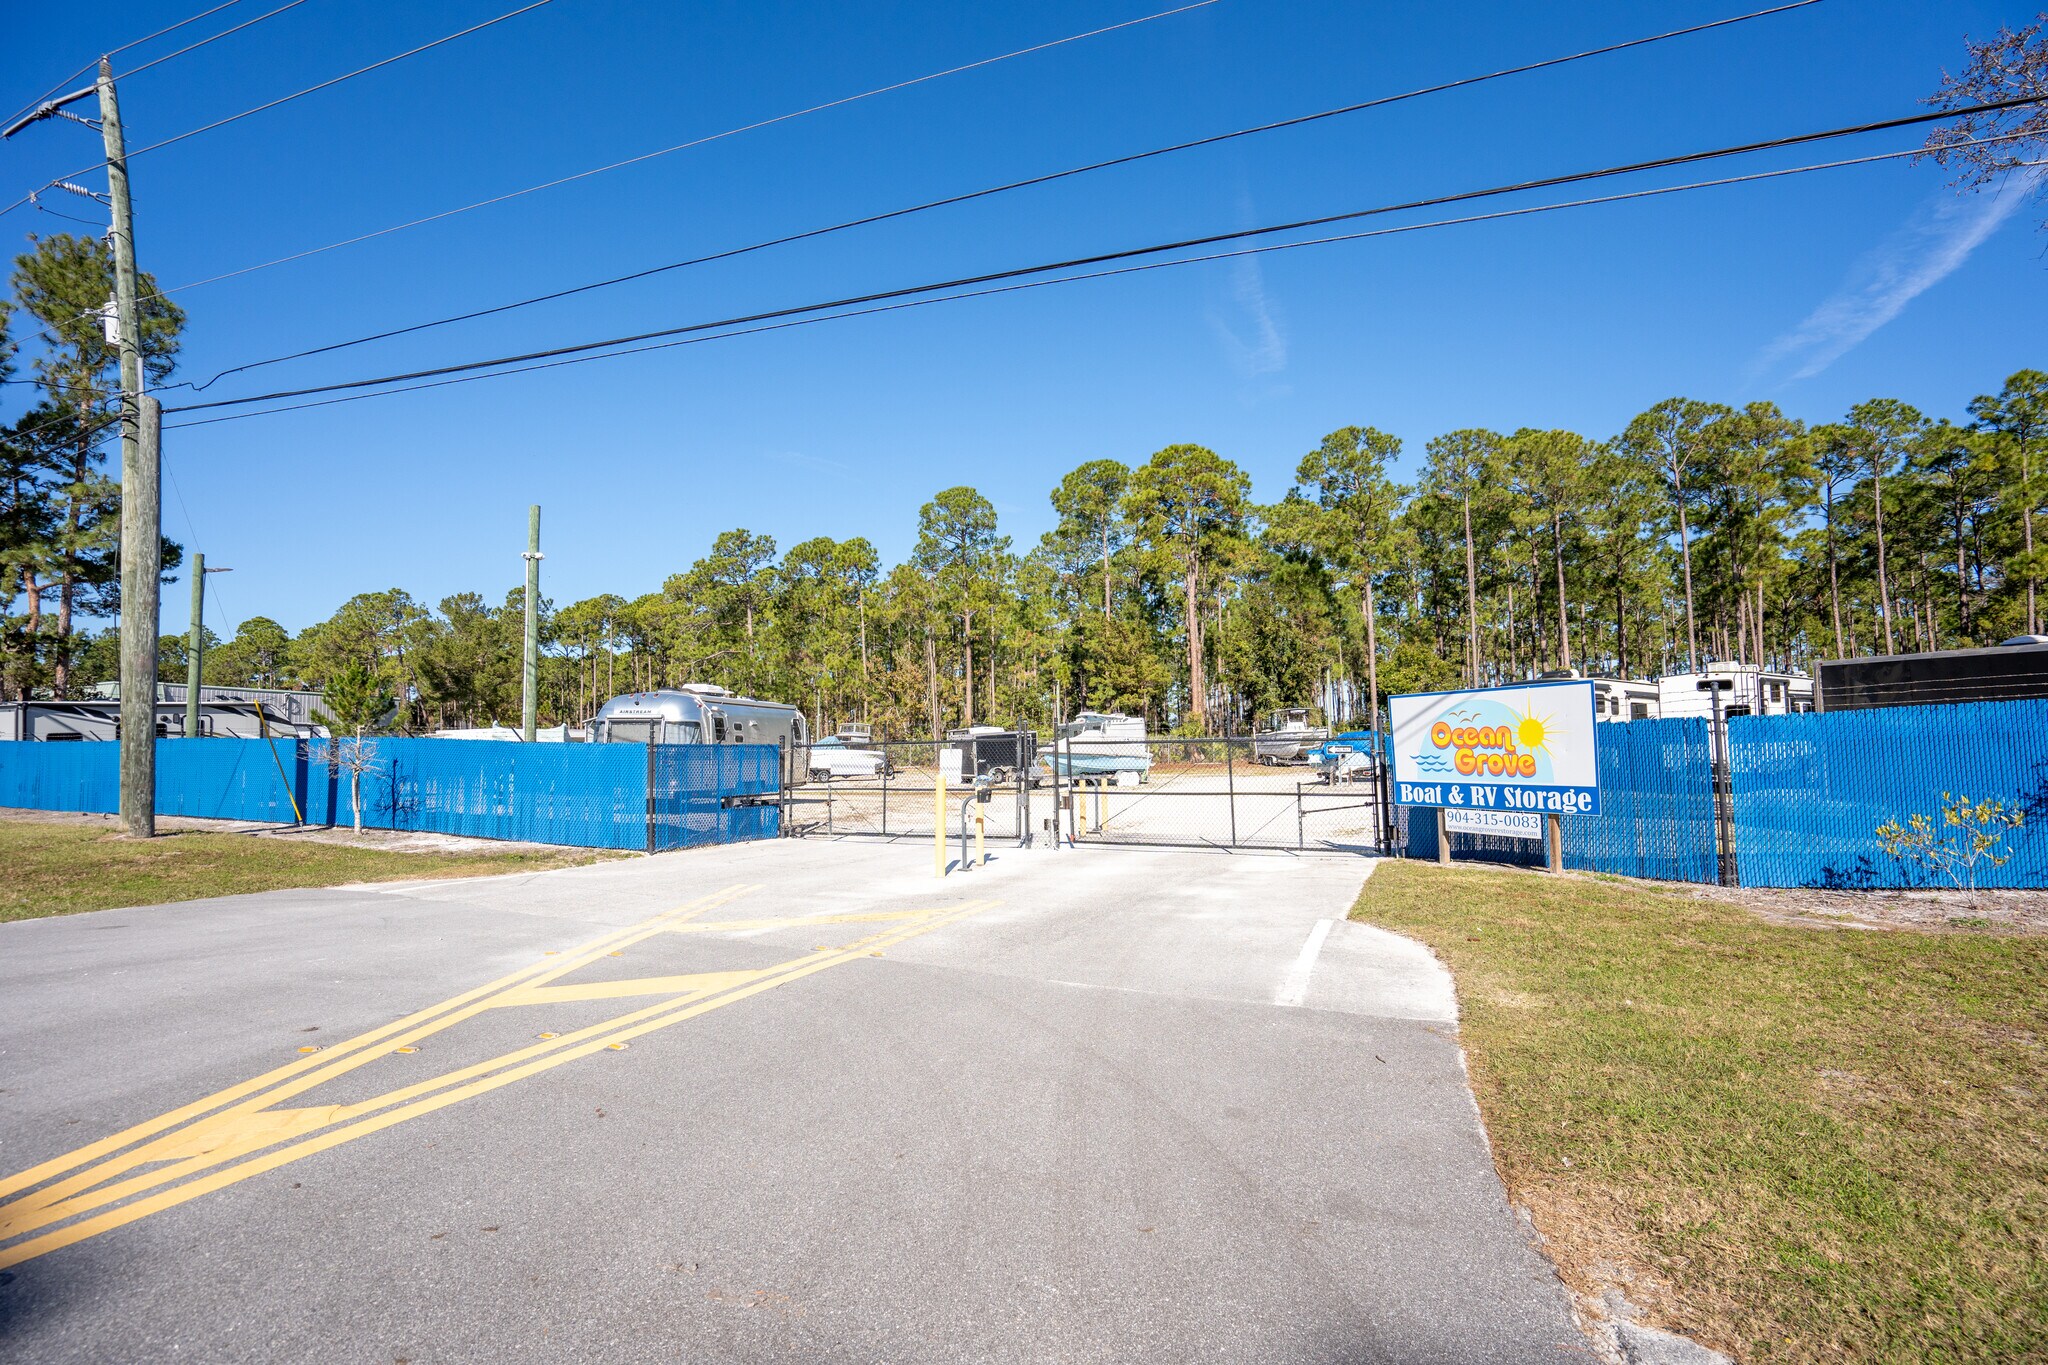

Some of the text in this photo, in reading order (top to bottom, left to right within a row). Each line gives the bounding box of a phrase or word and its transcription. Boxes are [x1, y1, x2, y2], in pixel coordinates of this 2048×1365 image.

[1431, 721, 1516, 752] Ocean
[1454, 747, 1536, 777] Grove
[1400, 784, 1592, 813] Boat & RV Storage
[1447, 811, 1539, 829] 904-315-0083
[1447, 824, 1538, 837] www.oceangrovervstorage.com
